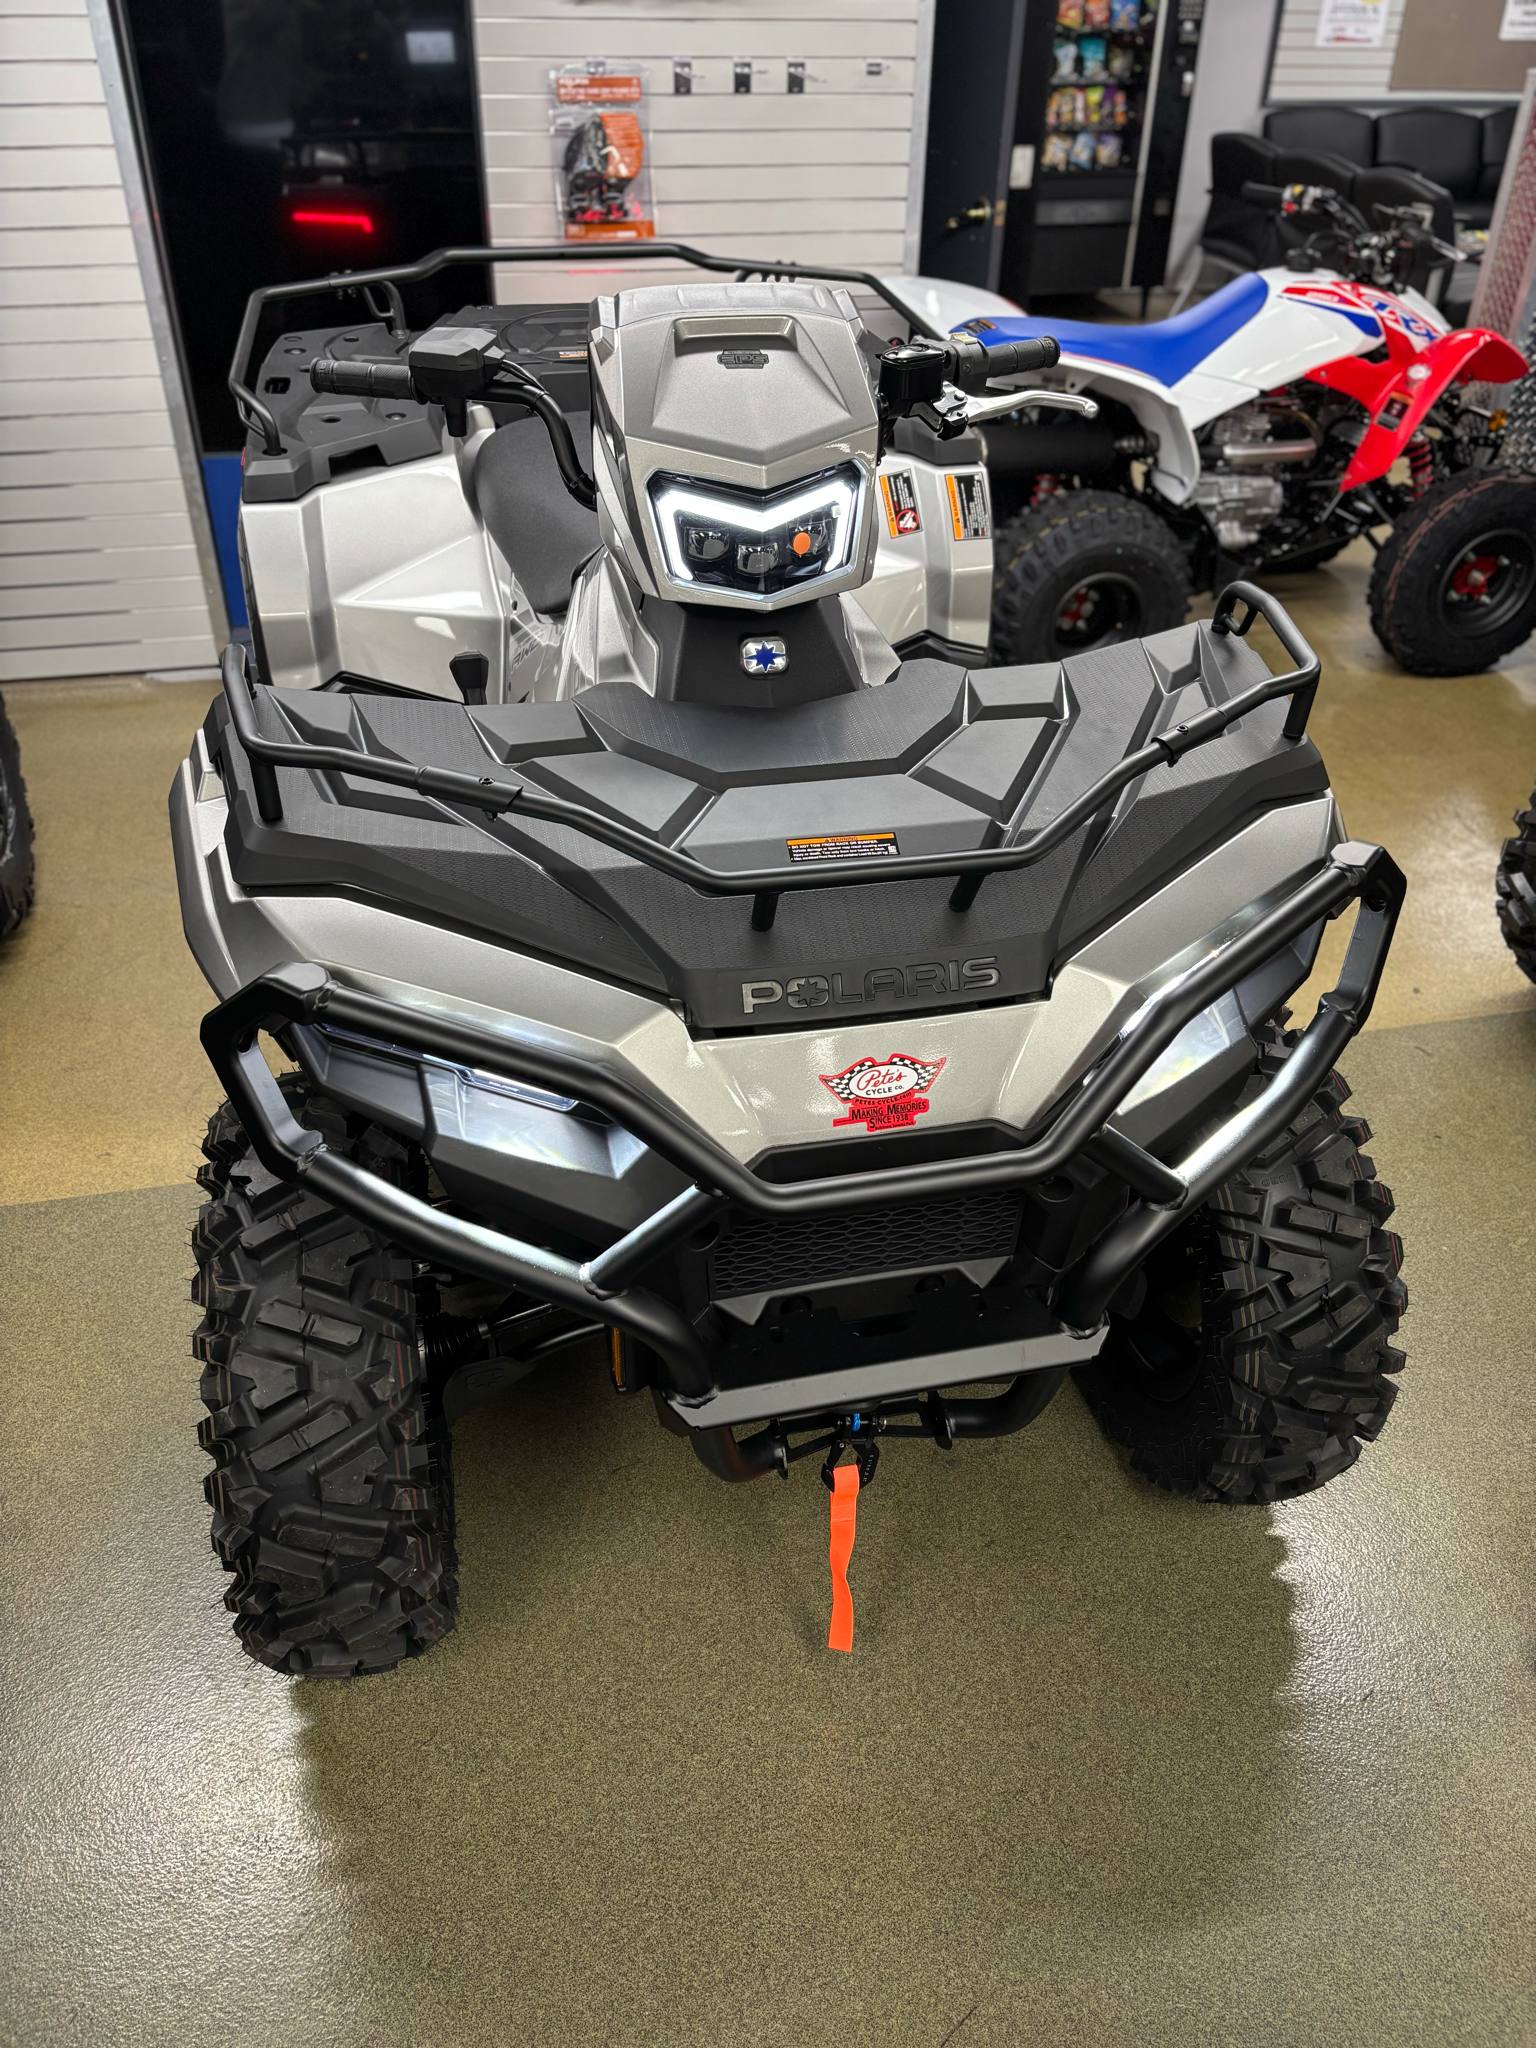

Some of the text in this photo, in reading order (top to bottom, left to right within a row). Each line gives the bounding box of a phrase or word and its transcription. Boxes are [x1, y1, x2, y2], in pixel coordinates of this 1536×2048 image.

[741, 957, 1000, 1014] POLARIS
[856, 1069, 907, 1091] Pete's
[865, 1086, 893, 1096] CYCLE
[851, 1101, 927, 1121] MAKING MEMORIES
[869, 1116, 892, 1129] SINCE
